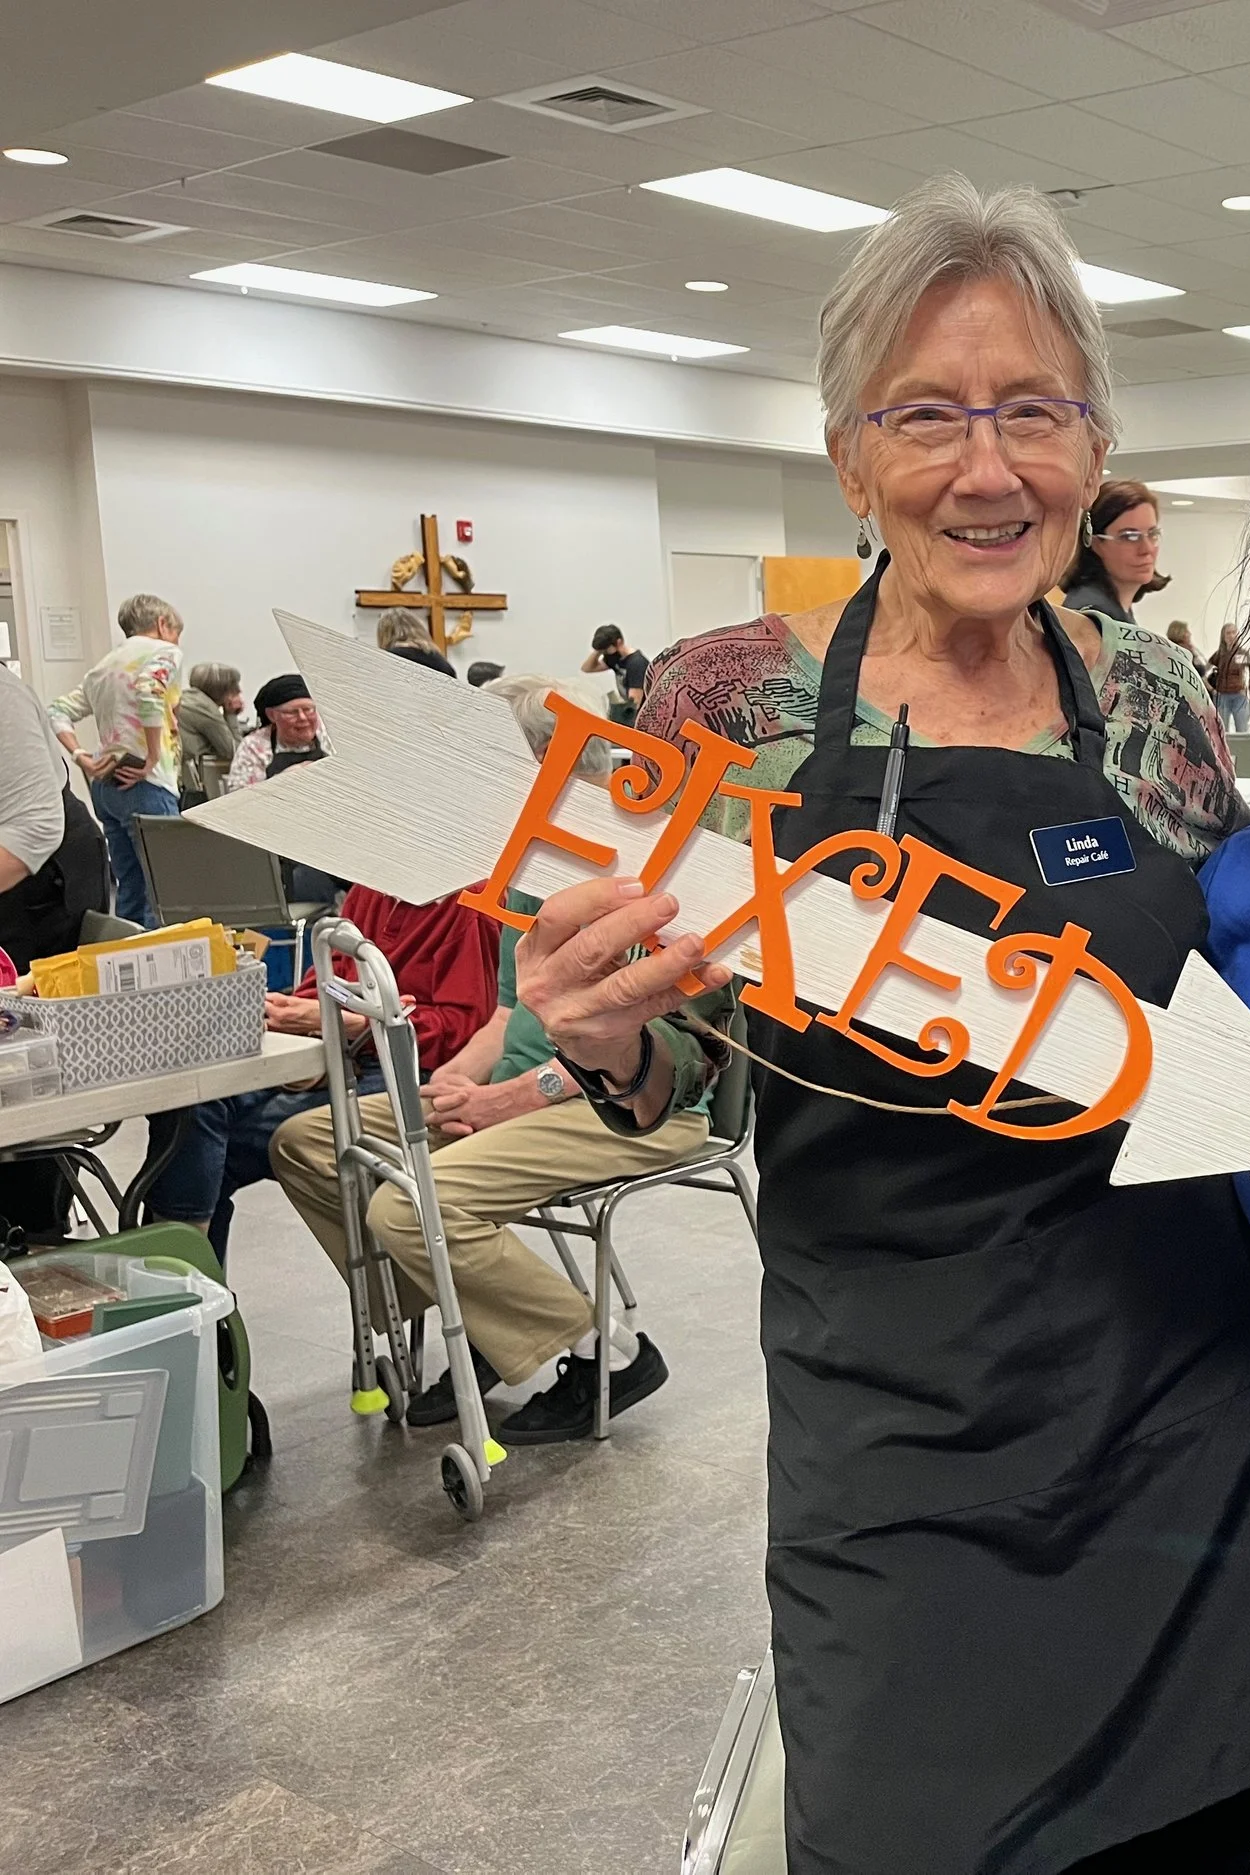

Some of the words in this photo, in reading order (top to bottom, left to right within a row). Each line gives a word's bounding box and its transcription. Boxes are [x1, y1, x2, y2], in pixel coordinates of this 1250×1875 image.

[1065, 835, 1100, 853] Linda
[1064, 855, 1091, 867] Repair
[1091, 850, 1110, 862] Café
[458, 691, 1153, 1140] FIXED
